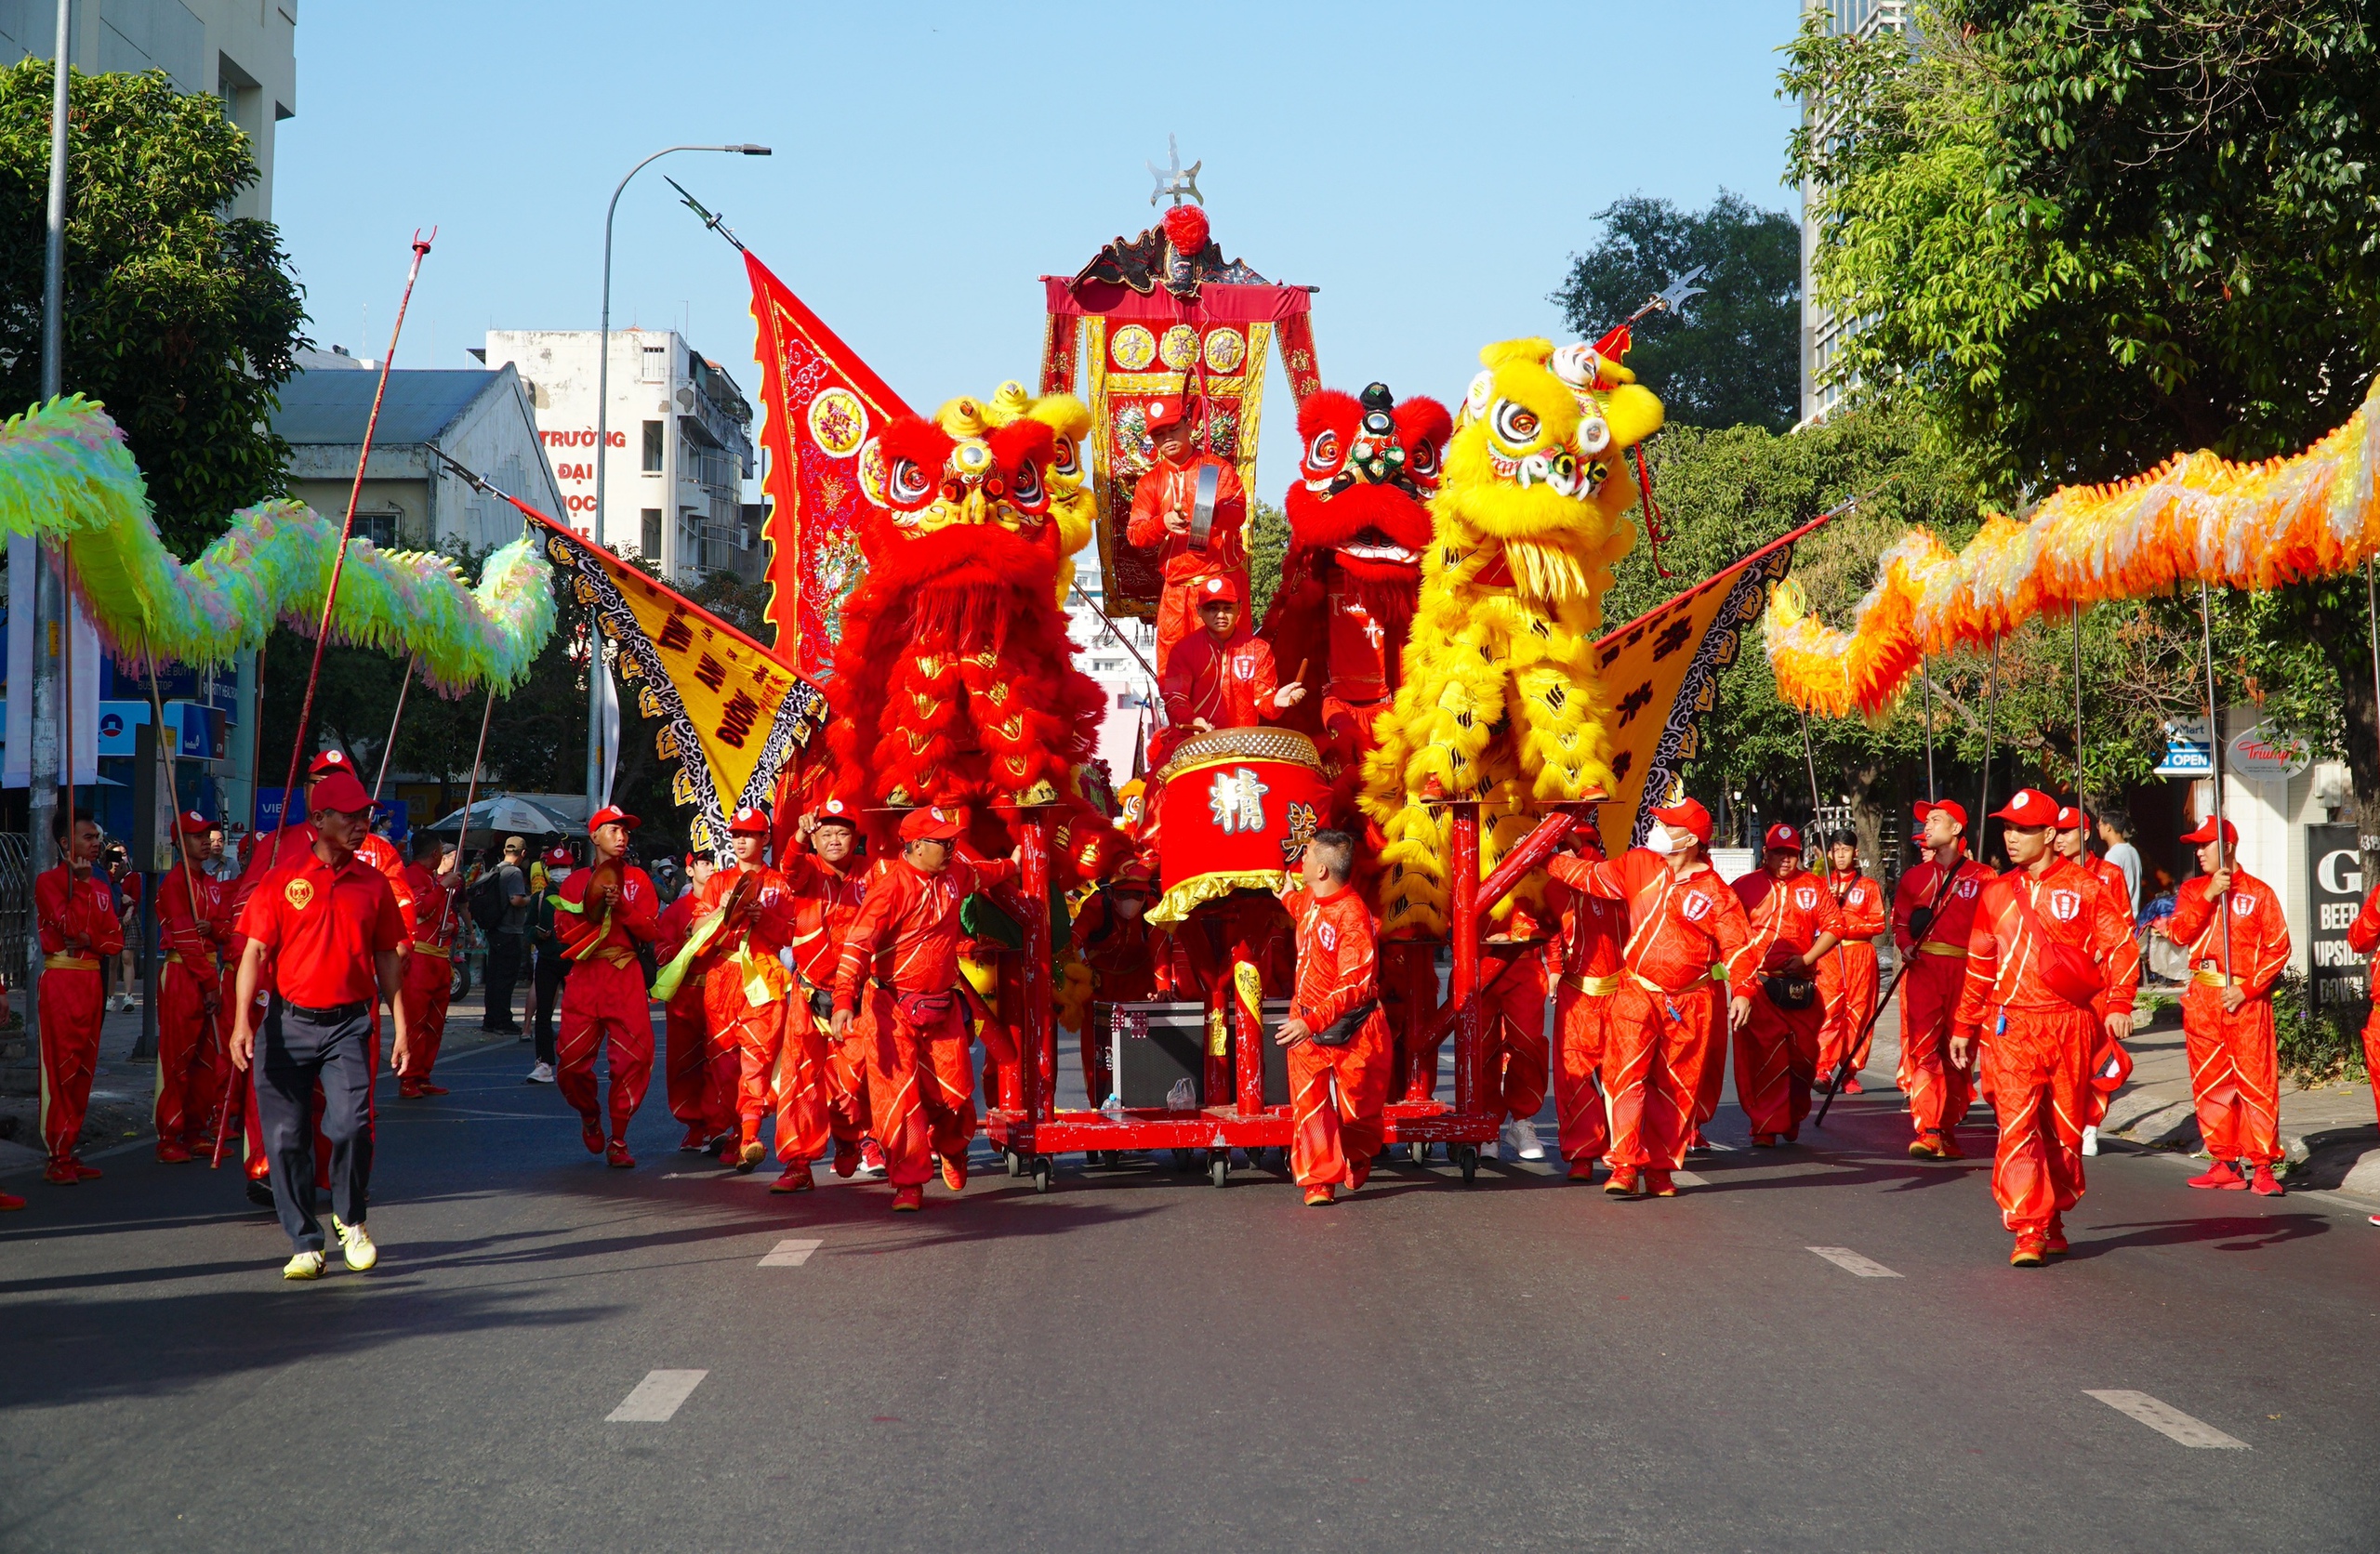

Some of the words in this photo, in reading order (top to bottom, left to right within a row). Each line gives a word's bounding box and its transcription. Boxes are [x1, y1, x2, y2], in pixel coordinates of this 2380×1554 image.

[558, 463, 592, 484] ĐẠI
[2172, 754, 2207, 766] OPEN
[2318, 849, 2363, 894] G
